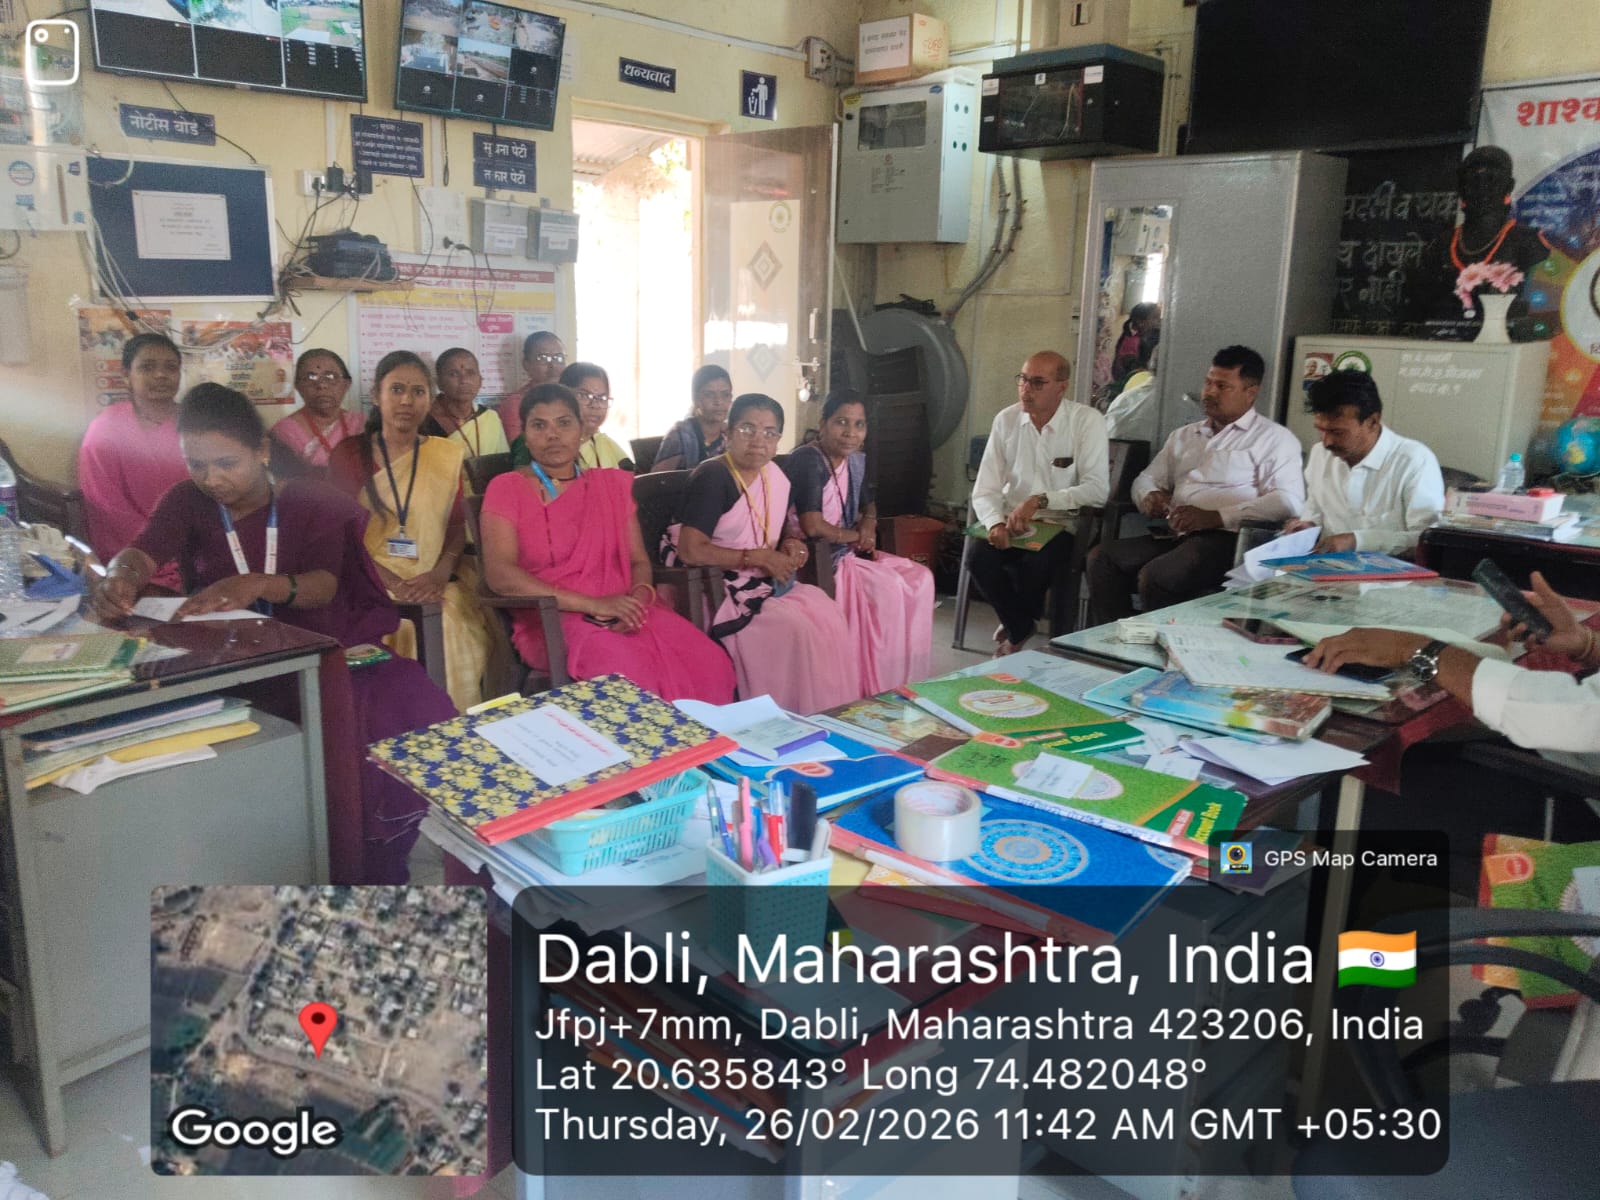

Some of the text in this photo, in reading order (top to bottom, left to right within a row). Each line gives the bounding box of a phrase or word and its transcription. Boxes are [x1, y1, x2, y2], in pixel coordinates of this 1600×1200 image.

[624, 63, 672, 87] धन्यवाद
[128, 110, 170, 133] नोटीस
[511, 141, 528, 158] पेटी
[510, 168, 527, 185] पेटी
